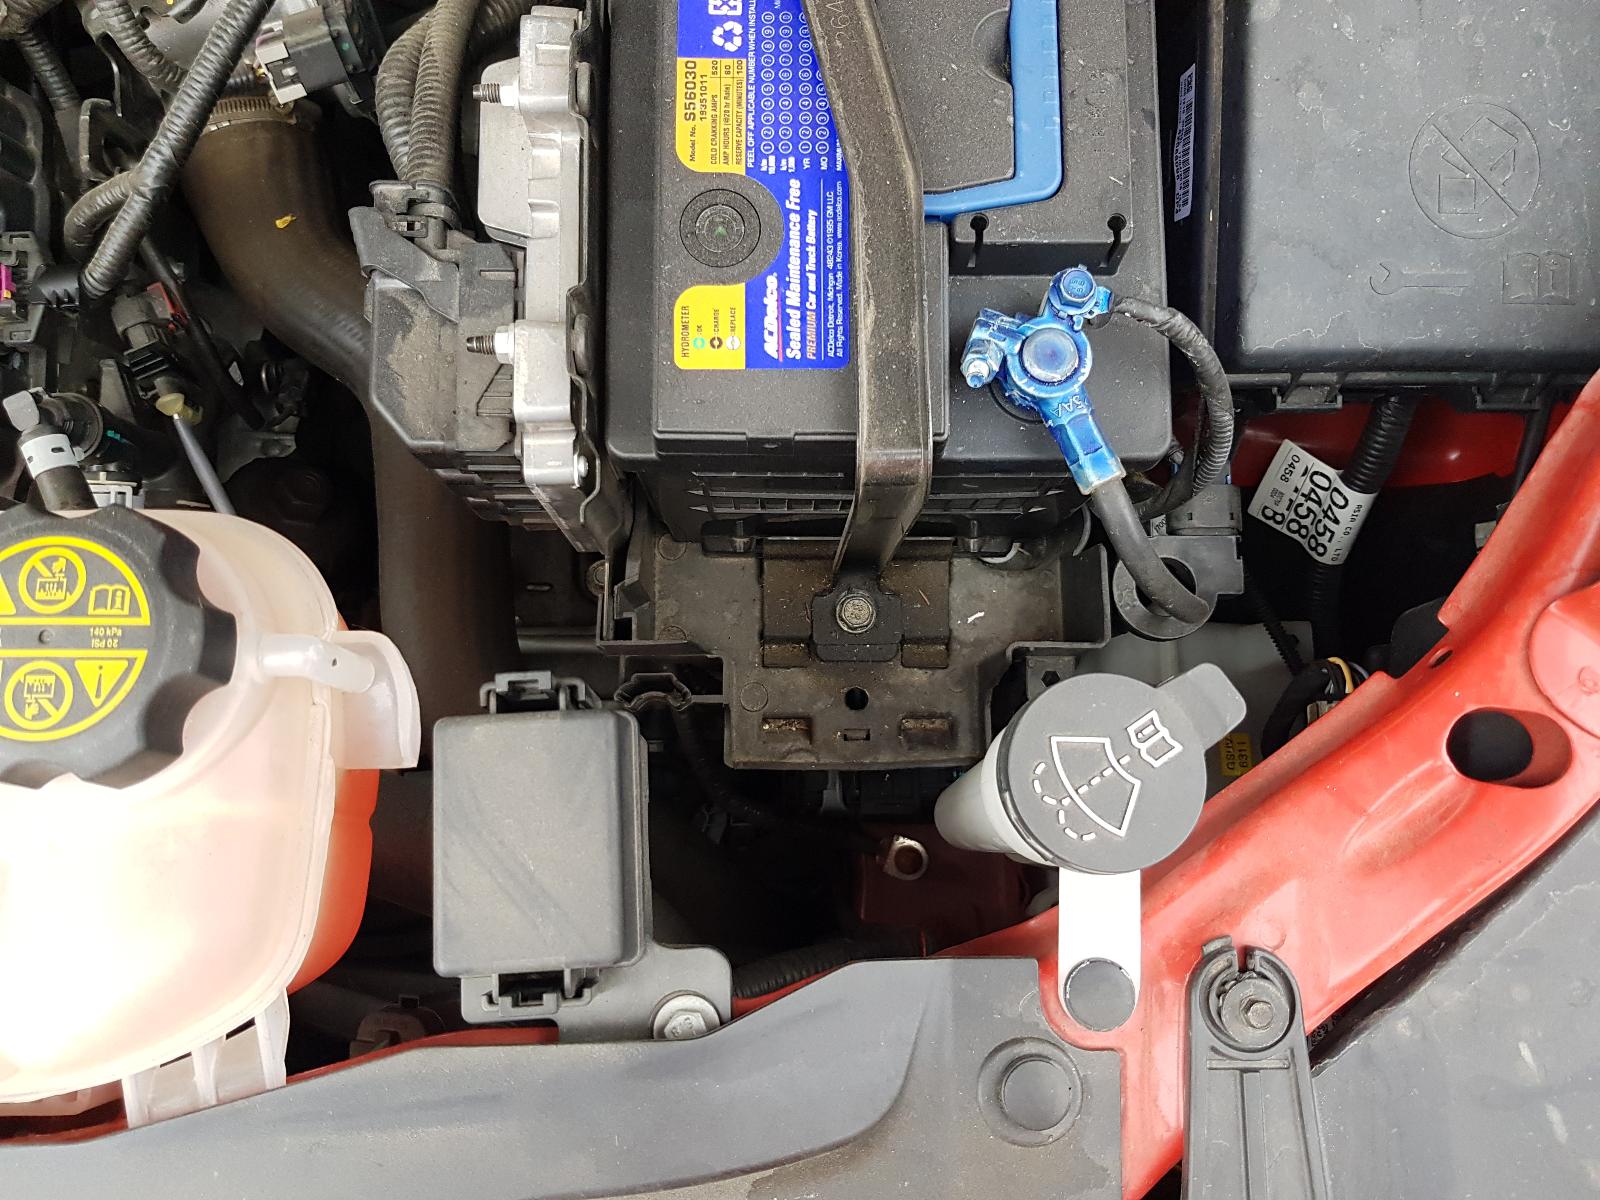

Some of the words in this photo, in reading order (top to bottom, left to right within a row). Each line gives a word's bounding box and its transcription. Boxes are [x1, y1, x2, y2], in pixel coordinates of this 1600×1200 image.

[748, 29, 756, 50] WHEN
[748, 52, 756, 84] NUMBER
[684, 60, 696, 122] S56030
[748, 85, 756, 130] APPLICABLE
[710, 114, 718, 146] CRANKING
[710, 148, 718, 165] COLD
[803, 158, 810, 170] YR
[820, 157, 828, 170] MO
[786, 178, 801, 210] Free
[826, 192, 834, 204] LLC
[826, 205, 834, 218] GM
[806, 209, 818, 244] Battery
[786, 212, 801, 307] Maintenance
[806, 246, 816, 272] Truck
[806, 272, 816, 292] and
[806, 292, 816, 310] Car
[763, 275, 778, 360] ACDelco
[681, 305, 690, 358] HYDROMETER
[786, 308, 802, 360] Sealed
[806, 310, 817, 360] PREMIUM
[836, 326, 844, 348] Rights
[1280, 454, 1300, 483] 0458
[1286, 470, 1332, 540] 0458
[1350, 504, 1362, 522] ASIA
[1308, 486, 1349, 557] 0458
[90, 626, 104, 637] 140
[106, 626, 122, 637] kPa
[92, 638, 106, 649] PSI
[107, 638, 118, 648] 20
